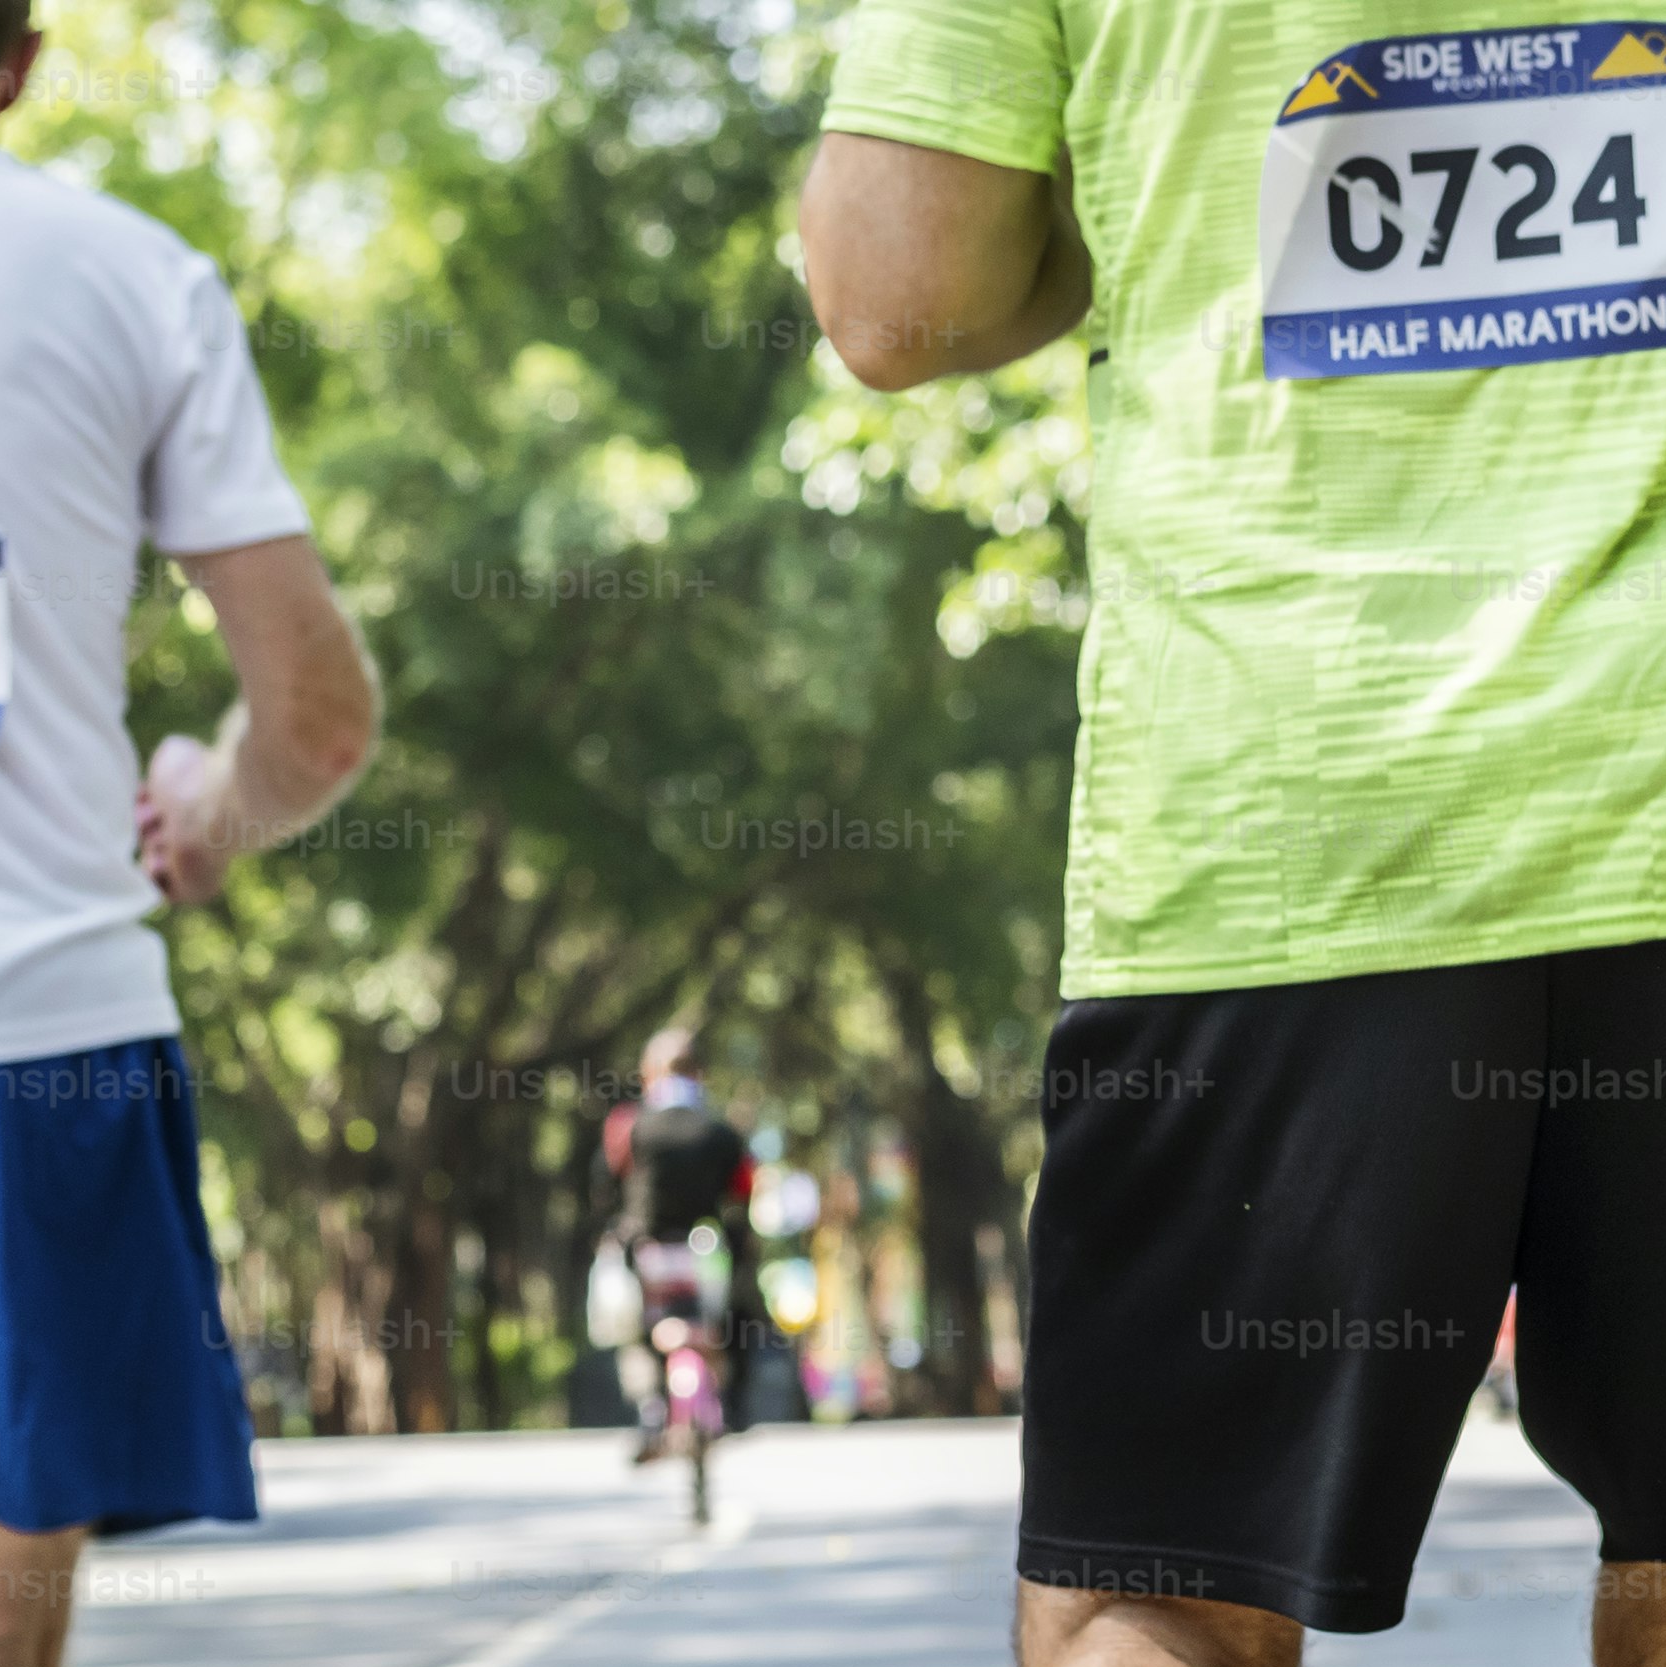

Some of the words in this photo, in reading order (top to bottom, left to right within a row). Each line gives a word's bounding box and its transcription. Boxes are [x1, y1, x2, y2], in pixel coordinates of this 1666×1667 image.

[1382, 40, 1463, 81] SIDE
[1471, 31, 1581, 73] WEST
[1327, 133, 1647, 273] 0724
[1329, 319, 1429, 360] HALF
